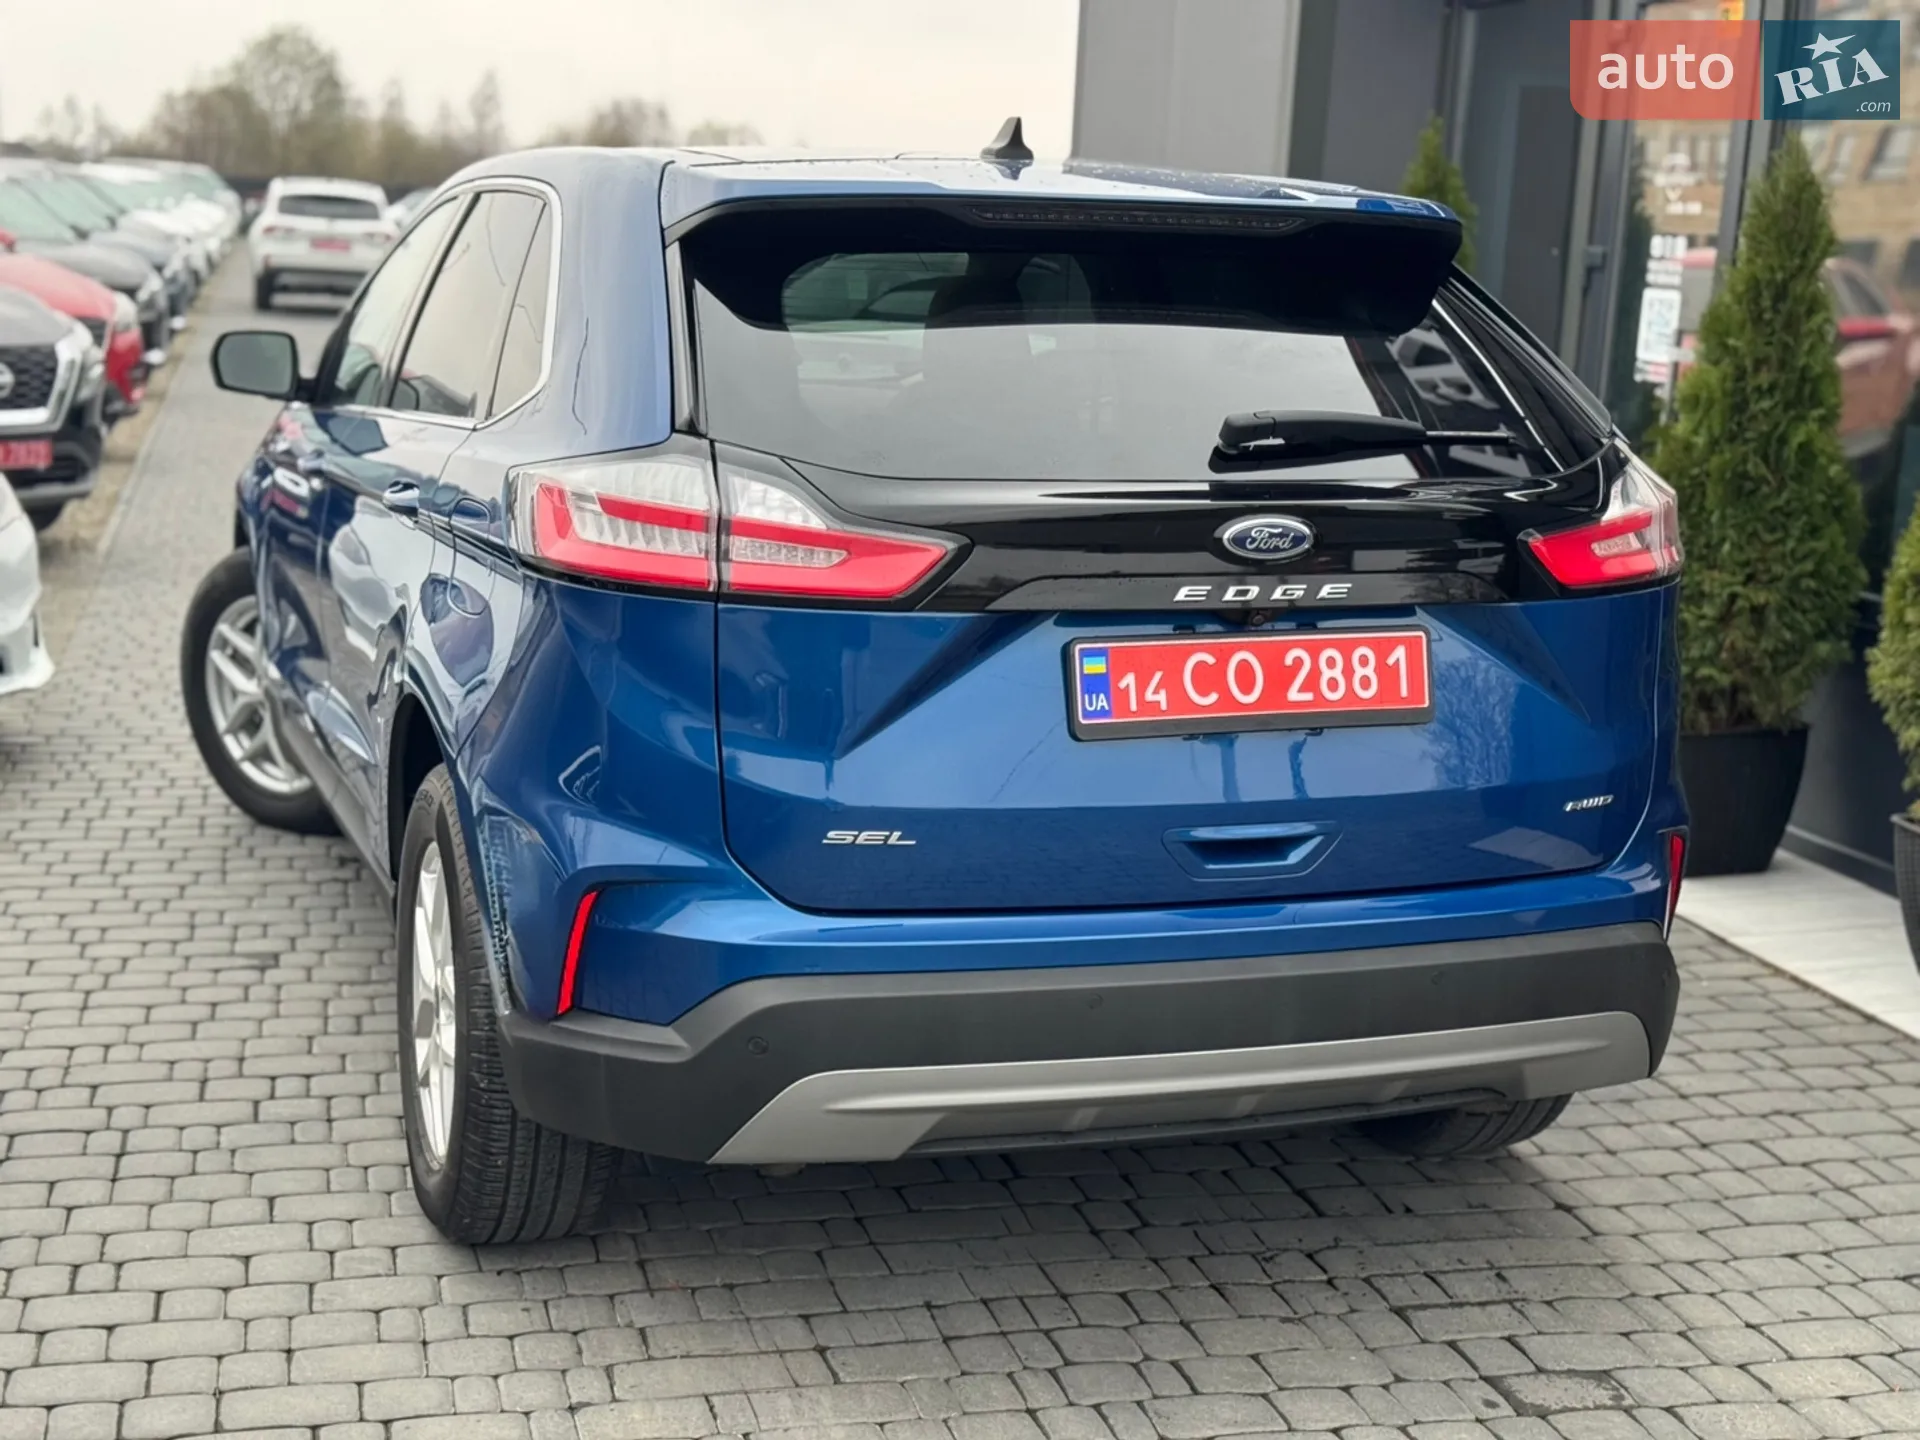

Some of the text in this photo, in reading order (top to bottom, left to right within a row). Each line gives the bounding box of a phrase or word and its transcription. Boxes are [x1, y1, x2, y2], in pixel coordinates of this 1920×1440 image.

[1246, 527, 1295, 550] Ford
[1173, 583, 1353, 602] EDGE
[1117, 644, 1409, 713] 14 CO 2881
[1084, 693, 1109, 711] UA
[822, 830, 917, 845] SEL
